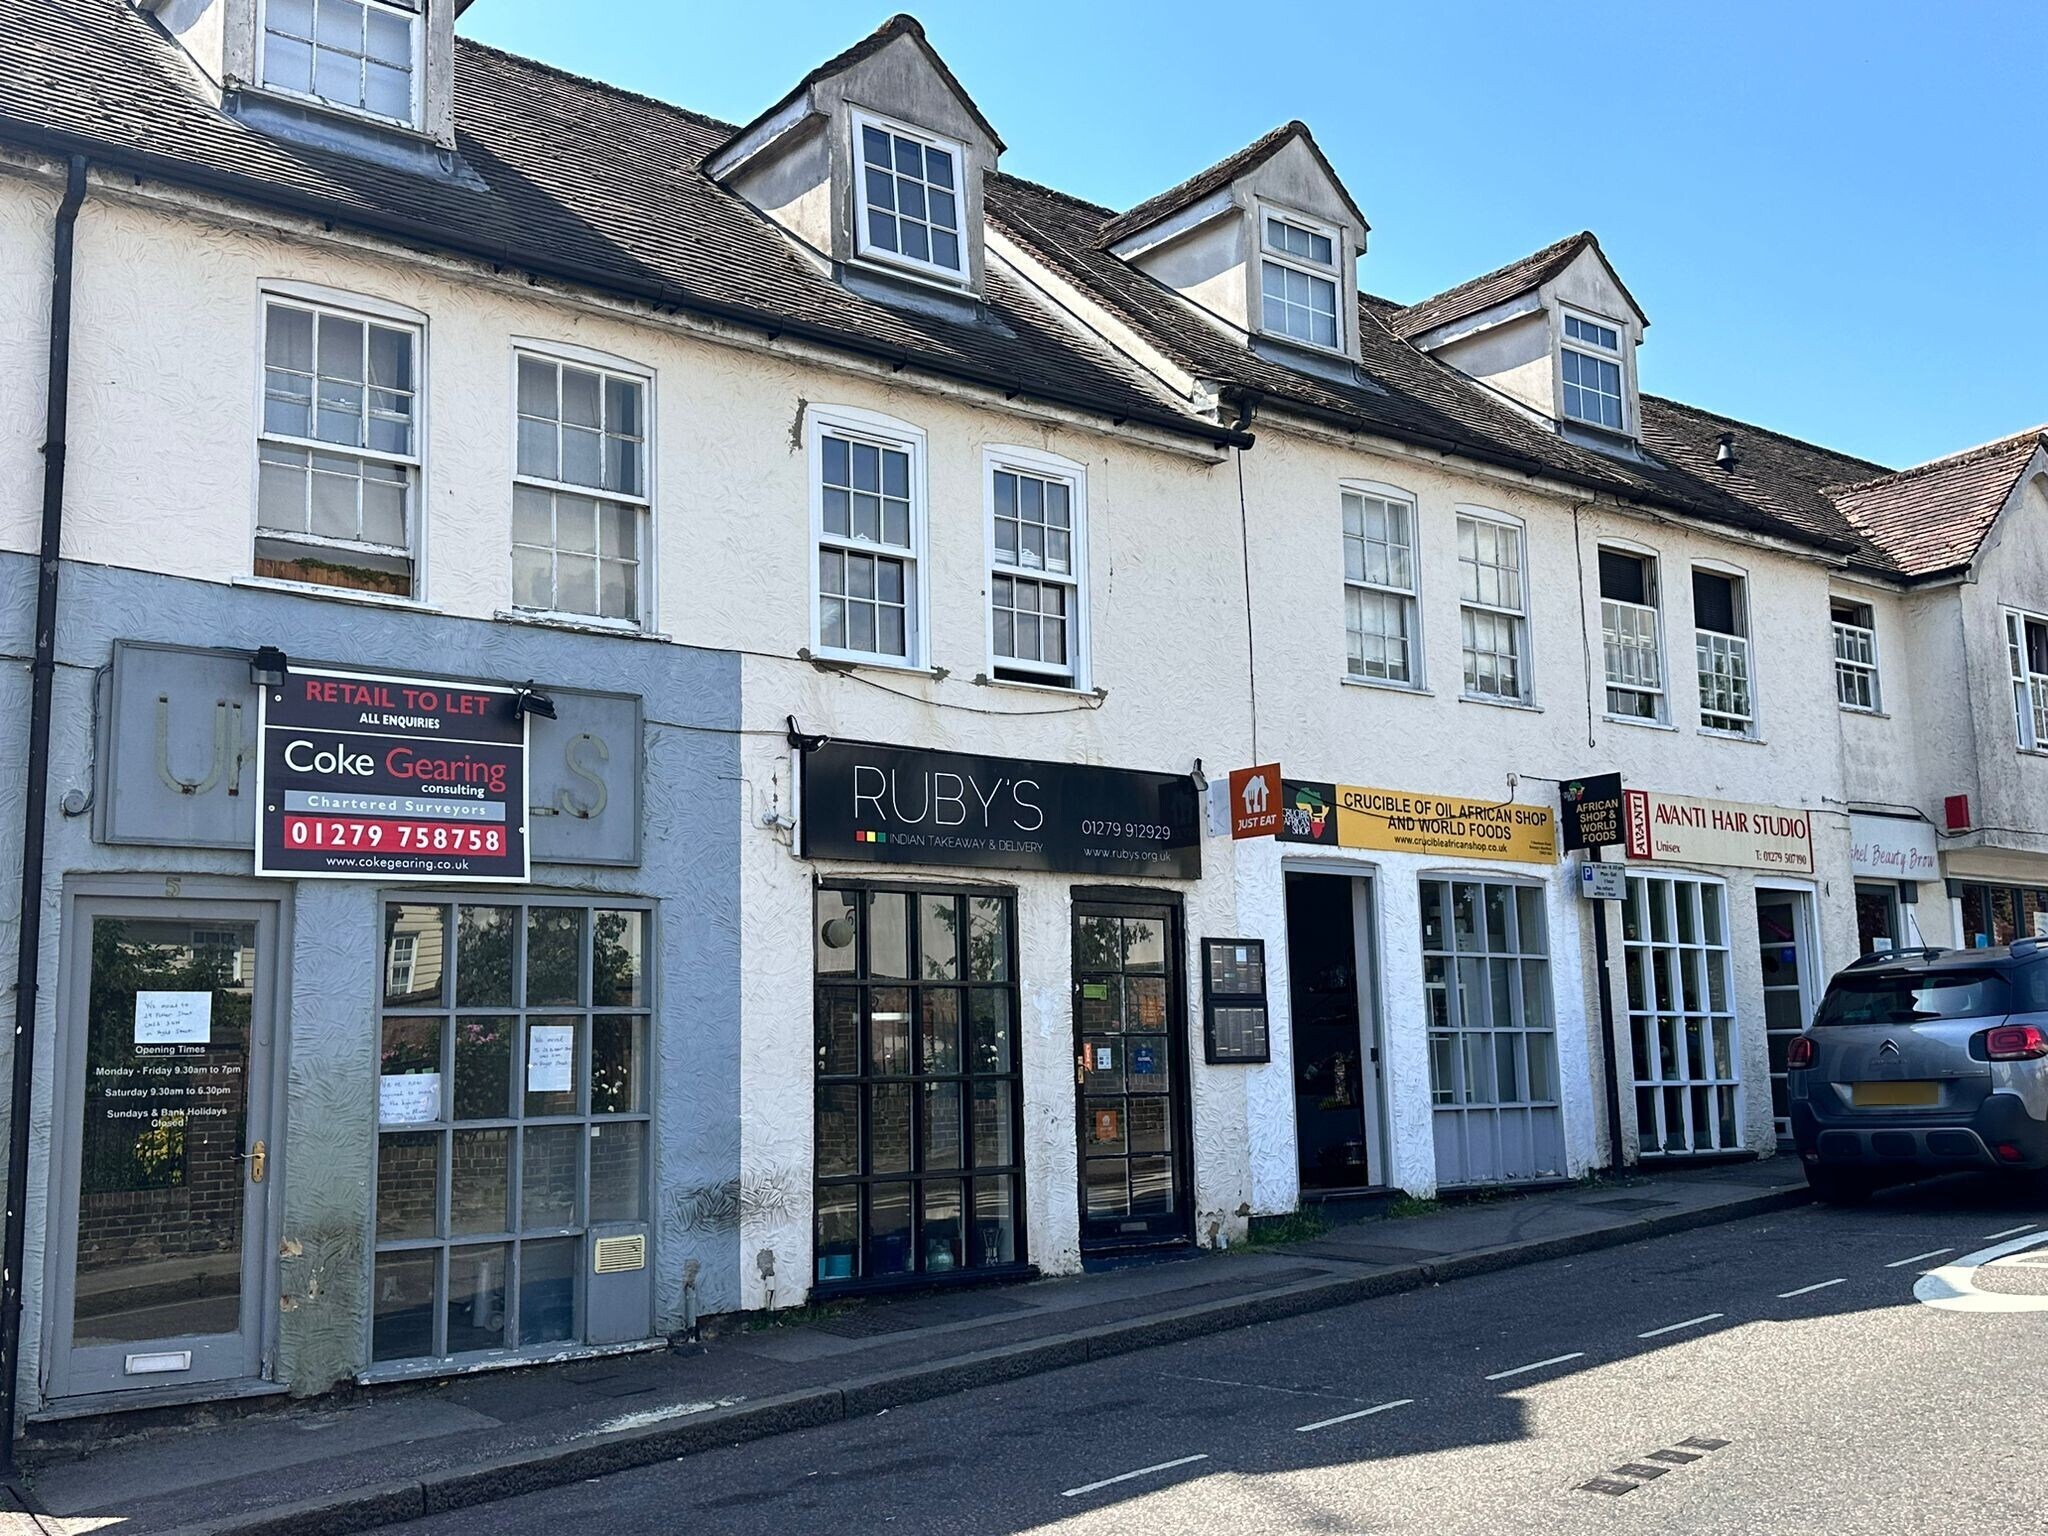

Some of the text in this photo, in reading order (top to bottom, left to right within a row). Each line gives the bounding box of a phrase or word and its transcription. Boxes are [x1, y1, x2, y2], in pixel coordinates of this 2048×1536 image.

[306, 681, 490, 715] RETAIL TO LET
[359, 712, 440, 729] ALL ENQUIRIES
[284, 740, 506, 792] Coke Gearing
[421, 783, 485, 799] consulting
[854, 765, 1043, 832] RUBY'S
[308, 795, 486, 816] Chartered Surveyors
[1344, 792, 1547, 827] CRUCIBLE OF OIL AFRICAN SHOP
[1576, 799, 1619, 813] AFRICAN
[1238, 814, 1277, 831] JUST EAT
[1580, 810, 1616, 823] SHOP &
[1632, 795, 1646, 854] AVANTI
[1655, 803, 1806, 839] AVANTI HAIR STUDIO
[1081, 819, 1171, 841] 01279 912929
[1388, 815, 1512, 840] AND WORLD FOODS
[1580, 820, 1617, 833] WORLD
[291, 822, 500, 850] 01279 758758
[889, 833, 1044, 854] INDIAN TAKEAWAY & DELIVERY
[1394, 835, 1508, 853] www.crucibleafricanshop.co.uk
[1582, 830, 1617, 843] FOODS
[1656, 840, 1681, 854] Unisex
[326, 857, 469, 871] www.cokegearing.co.uk
[1083, 848, 1172, 864] www.rubys.org.uk
[1763, 850, 1782, 862] 01279
[1872, 844, 1906, 874] Beauty
[1584, 868, 1591, 880] P
[135, 1045, 205, 1055] Opening Times
[95, 1066, 134, 1077] Monday
[142, 1066, 172, 1076] Friday
[174, 1065, 208, 1075] 9.30am
[209, 1066, 219, 1074] to
[221, 1065, 241, 1075] 7pm
[105, 1086, 231, 1098] Saturday 9.30am to 6.30pm
[106, 1107, 228, 1119] Sundays & Bank Holidays
